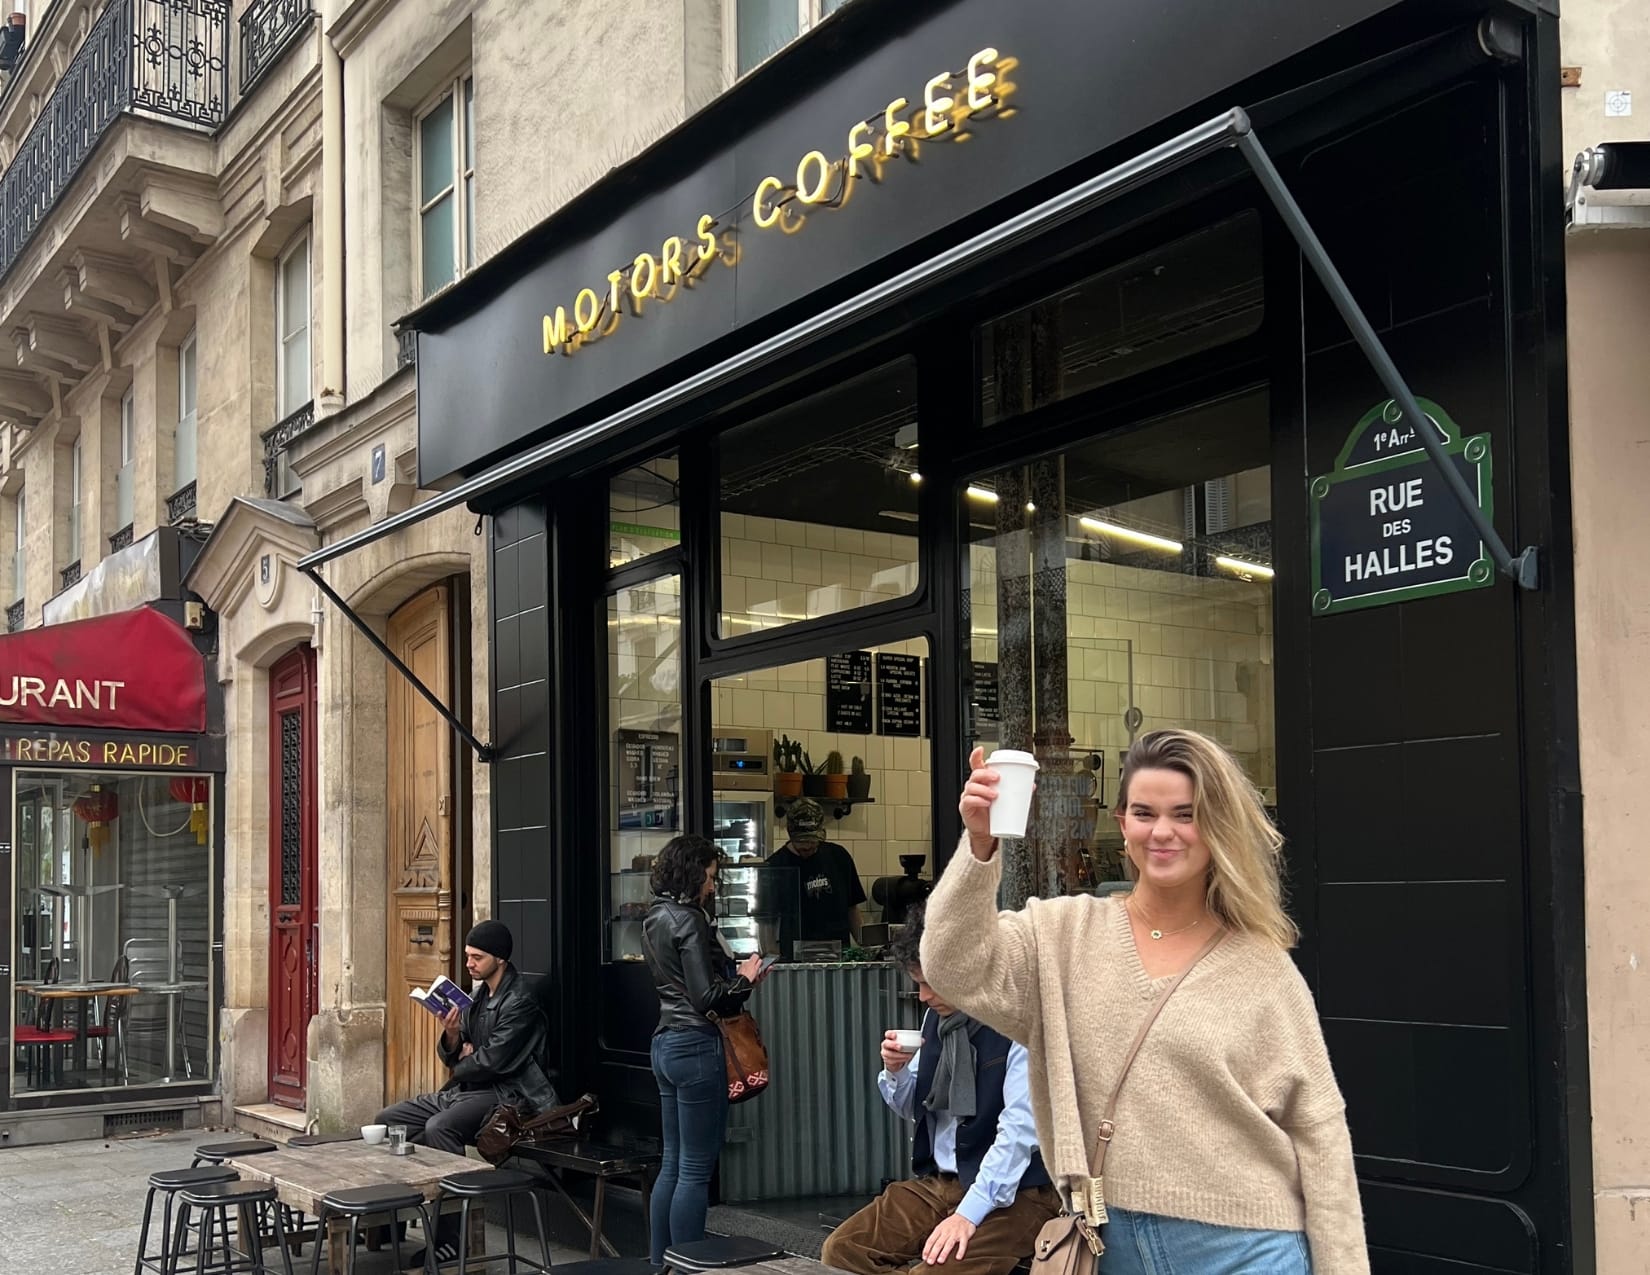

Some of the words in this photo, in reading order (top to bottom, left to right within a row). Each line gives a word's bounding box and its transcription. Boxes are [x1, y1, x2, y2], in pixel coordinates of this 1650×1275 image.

[542, 214, 716, 354] MOTORS
[753, 47, 999, 227] COFFEE
[374, 450, 382, 478] 7
[1370, 478, 1424, 516] RUE
[1383, 519, 1411, 537] DES
[262, 558, 268, 579] 5
[1345, 536, 1453, 582] HALLES
[17, 737, 91, 763] REPAS
[104, 742, 190, 766] RAPIDE
[807, 877, 828, 890] motors
